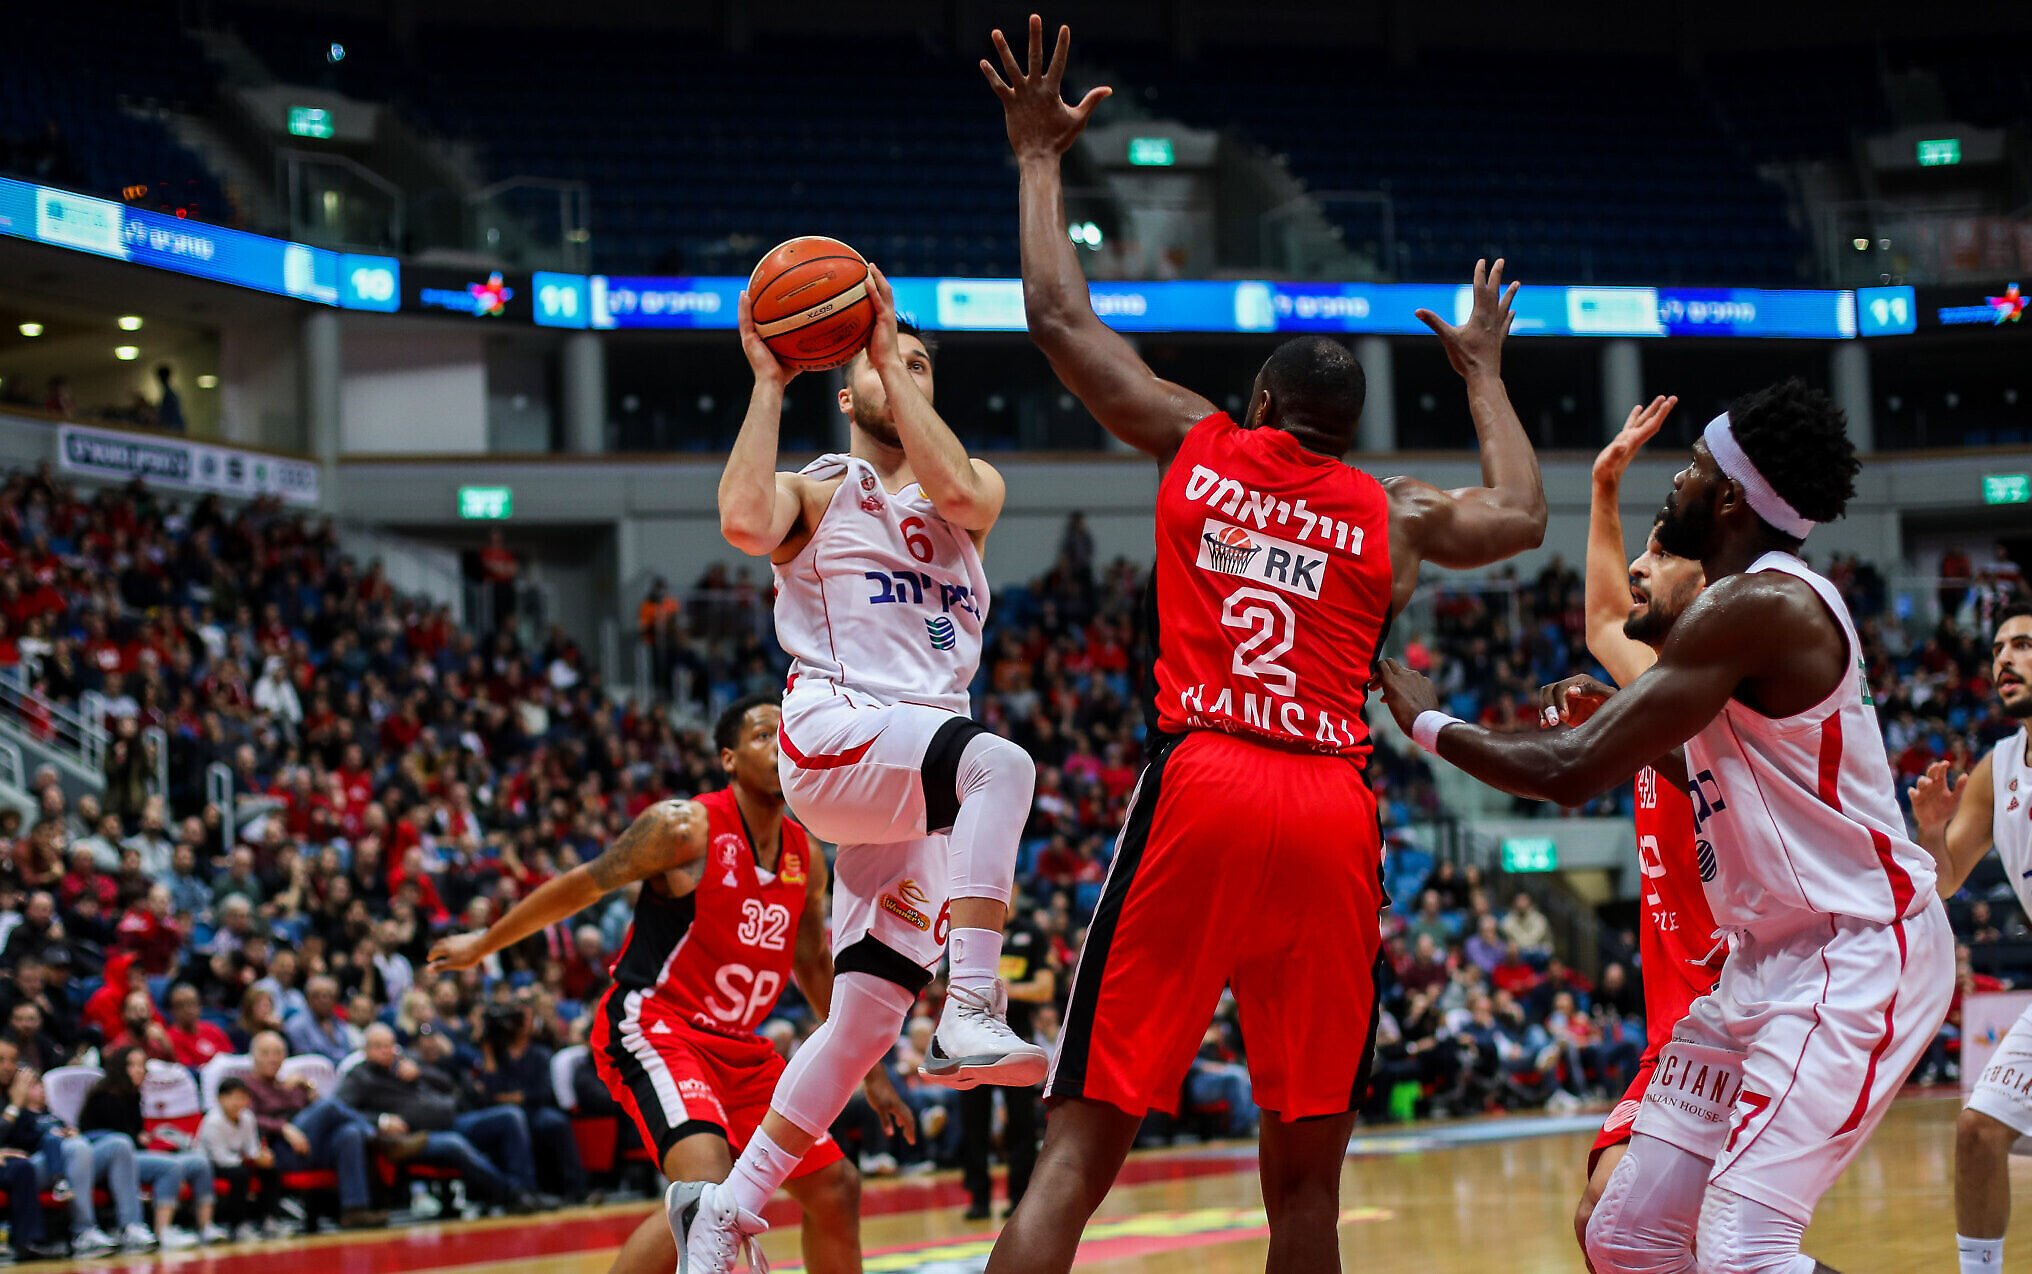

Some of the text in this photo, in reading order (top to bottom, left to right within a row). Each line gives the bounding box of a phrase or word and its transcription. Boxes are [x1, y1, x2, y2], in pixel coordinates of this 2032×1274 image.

[1184, 464, 1365, 555] וויליאמס
[899, 515, 935, 564] 6
[864, 570, 932, 605] יהב
[1263, 546, 1325, 593] RK
[1221, 586, 1297, 697] 2
[738, 898, 790, 951] 32
[885, 899, 918, 922] Winner
[934, 896, 951, 946] 6
[704, 962, 781, 1027] SP
[1725, 1089, 1772, 1153] 7
